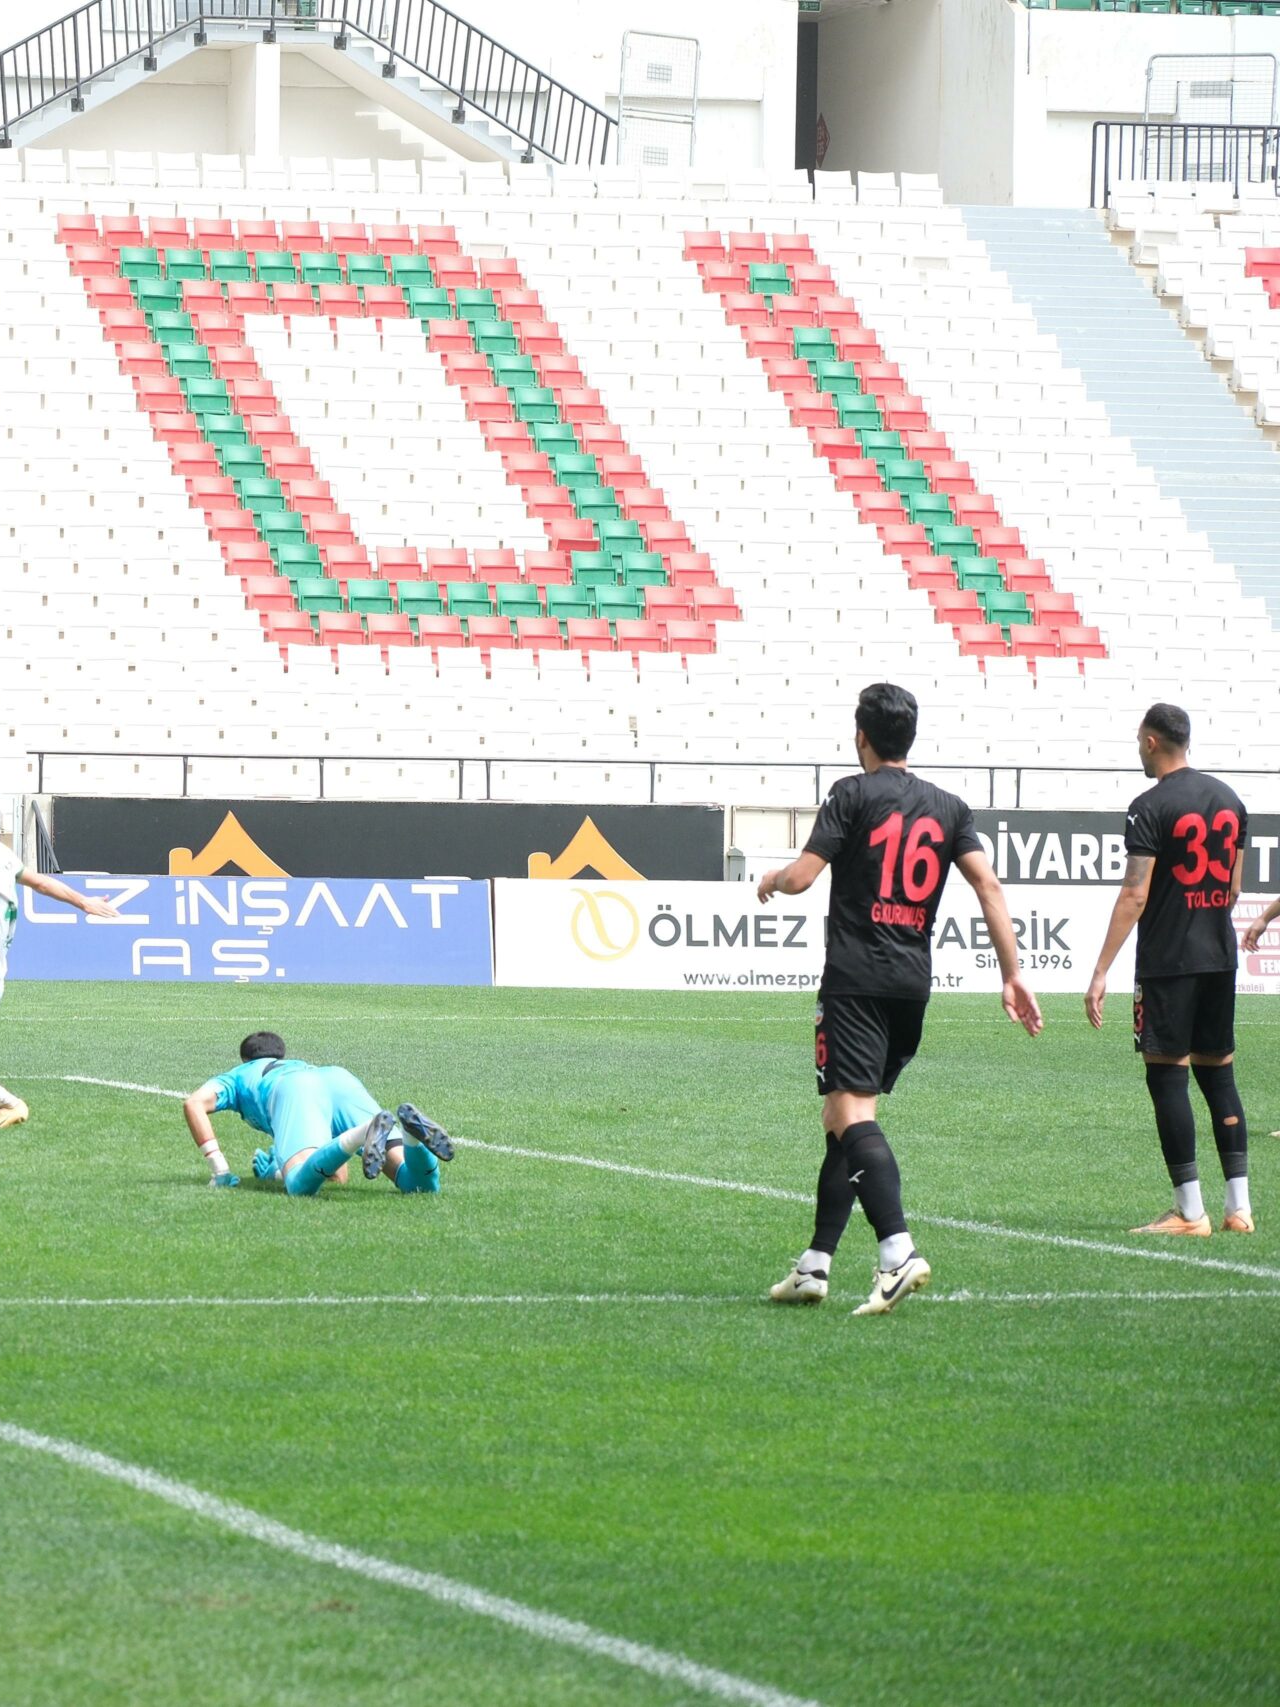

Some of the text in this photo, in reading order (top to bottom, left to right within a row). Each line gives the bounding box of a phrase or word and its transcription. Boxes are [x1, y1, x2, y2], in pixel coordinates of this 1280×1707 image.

[869, 811, 944, 902] 16
[974, 821, 1130, 882] DİYARB
[1171, 809, 1240, 886] 33
[648, 904, 808, 947] ÖLMEZ
[975, 953, 1072, 969] Sine 1996
